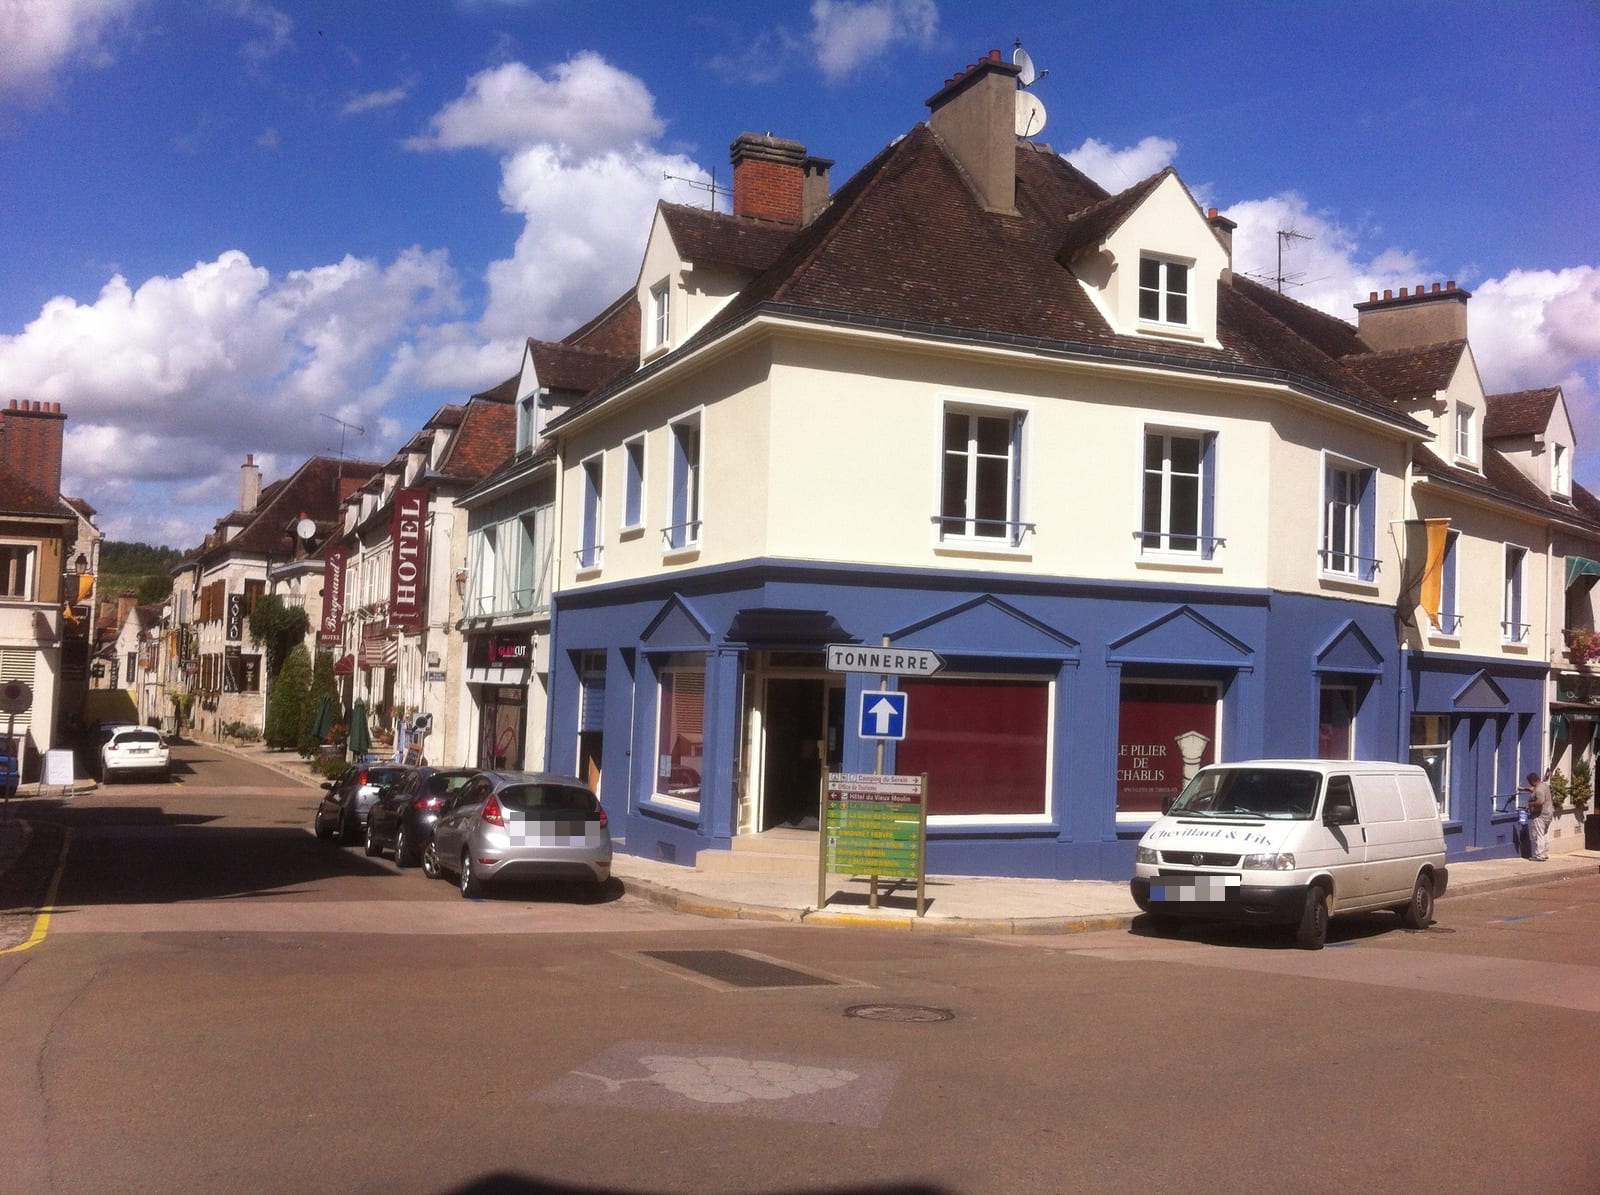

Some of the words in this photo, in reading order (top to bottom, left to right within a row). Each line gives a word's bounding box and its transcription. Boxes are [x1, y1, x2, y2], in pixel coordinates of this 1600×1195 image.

[397, 499, 420, 604] HOTEL
[835, 652, 928, 669] TONNERRE
[1117, 745, 1128, 756] E
[1131, 745, 1167, 756] PILIER
[1133, 757, 1149, 769] DE
[1116, 769, 1165, 781] CHABLIS
[1150, 828, 1222, 840] Chevillard
[1225, 831, 1236, 840] &
